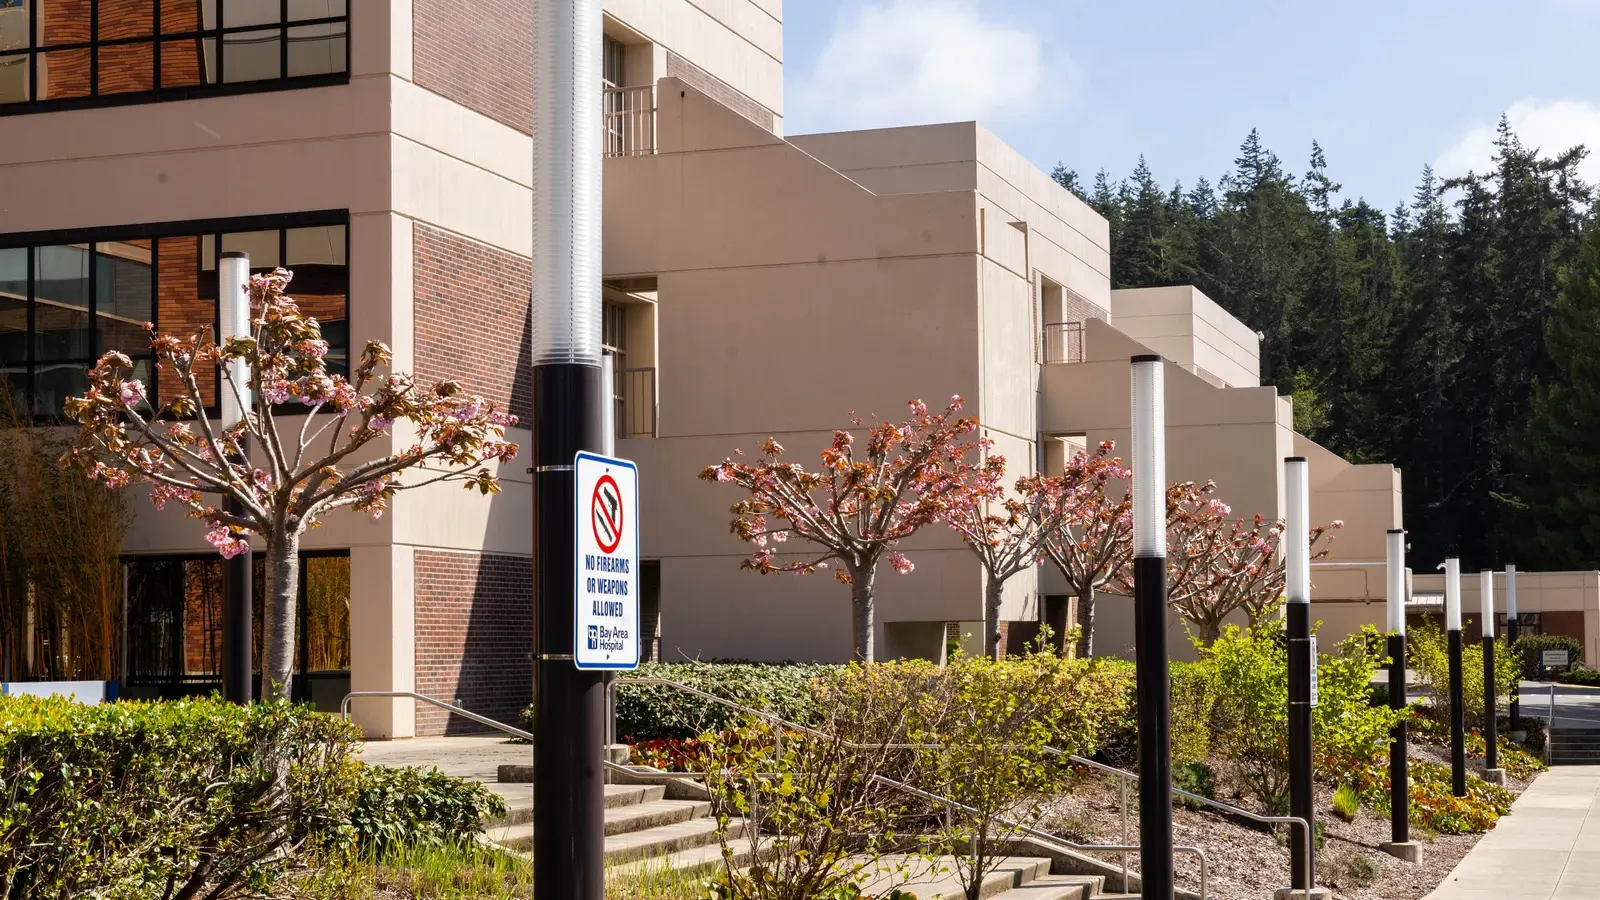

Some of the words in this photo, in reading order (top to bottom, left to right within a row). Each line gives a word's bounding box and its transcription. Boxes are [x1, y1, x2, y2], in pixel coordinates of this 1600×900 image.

[585, 554, 595, 571] NO
[596, 555, 630, 574] FIREARMS
[586, 577, 596, 593] OR
[597, 578, 628, 596] WEAPONS
[592, 600, 623, 617] ALLOWED
[599, 625, 612, 642] Bay
[612, 626, 628, 639] Area
[599, 638, 624, 653] Hospital
